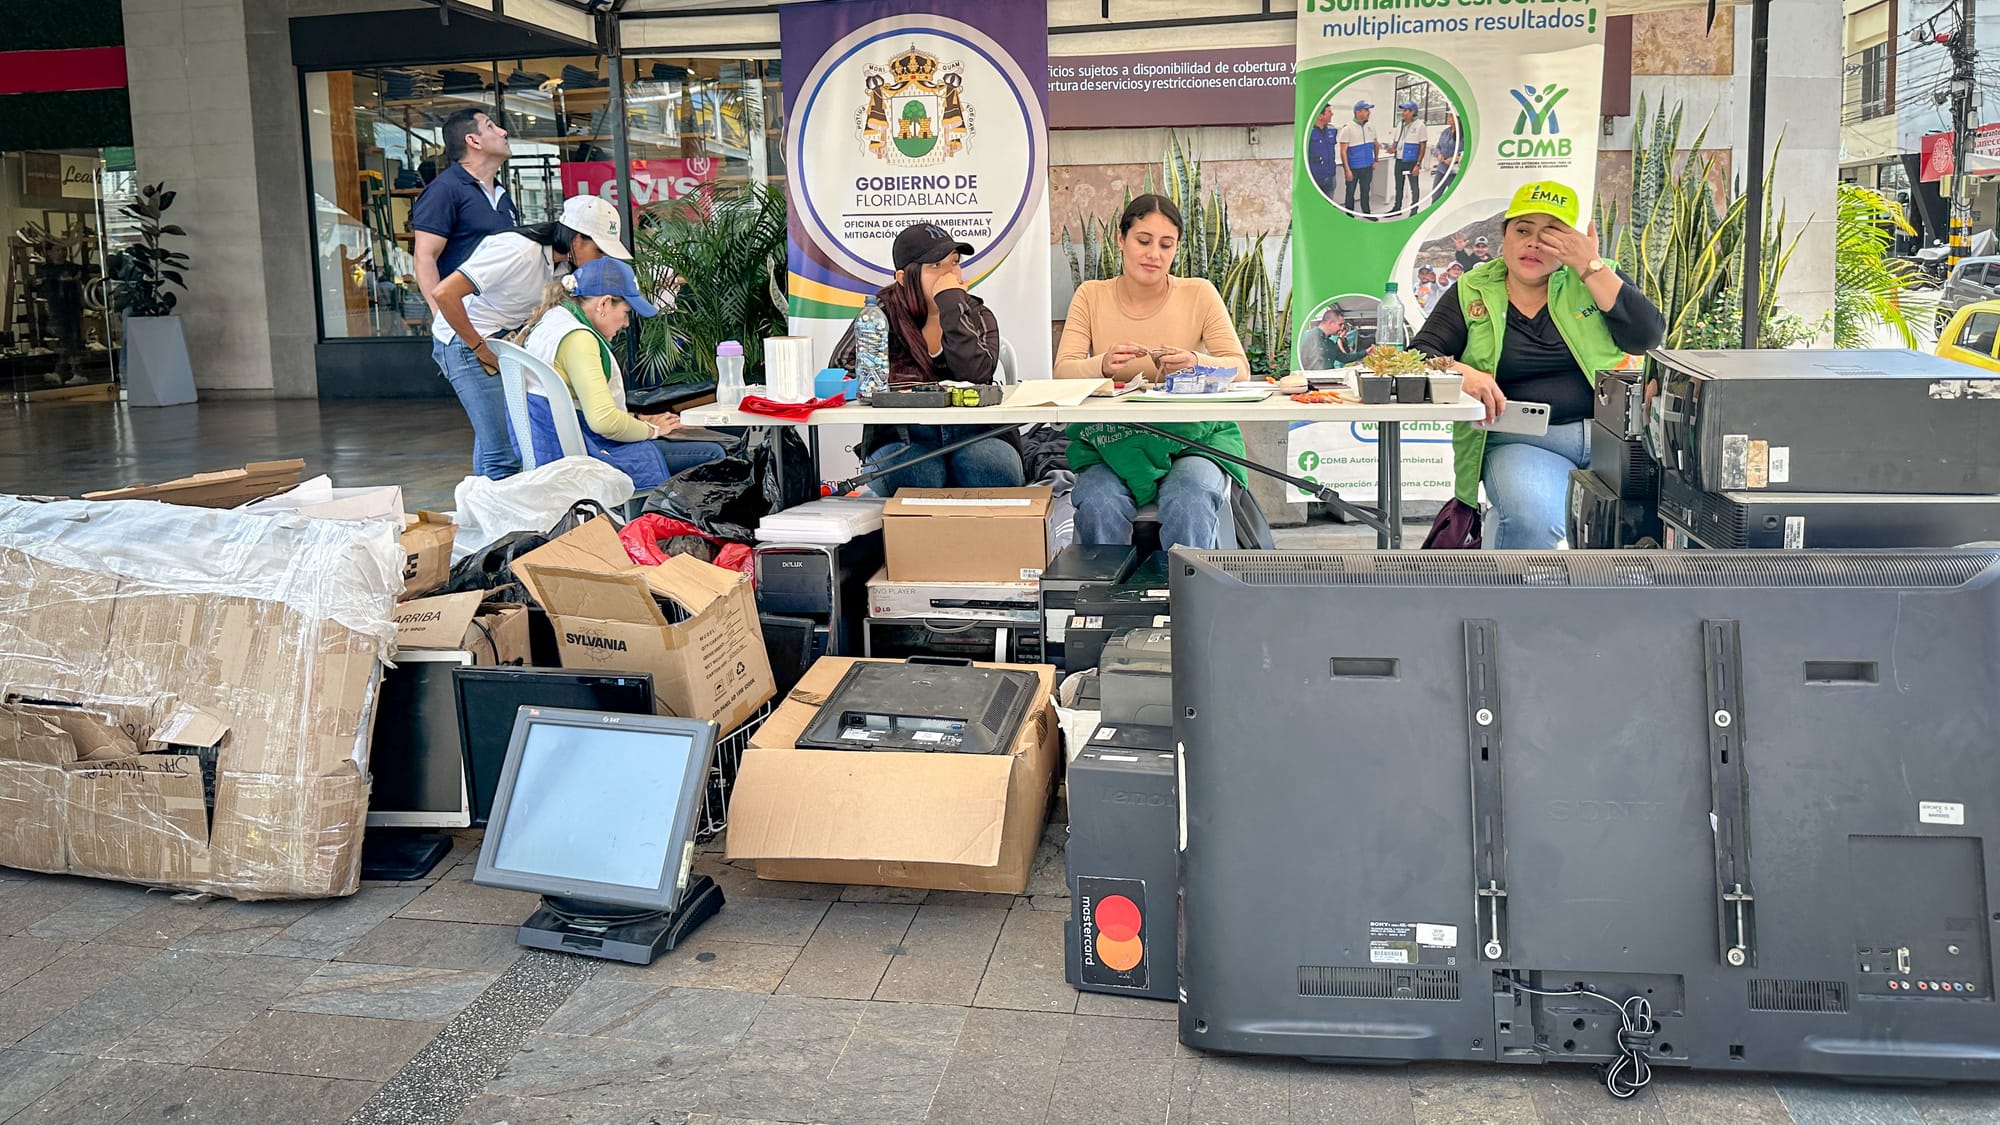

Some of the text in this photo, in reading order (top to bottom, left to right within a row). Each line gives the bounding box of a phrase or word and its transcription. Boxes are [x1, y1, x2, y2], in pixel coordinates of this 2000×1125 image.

[1323, 14, 1468, 40] multiplicamos
[942, 61, 960, 71] QUAM
[1078, 64, 1118, 79] sujetos
[1122, 66, 1129, 75] a
[1133, 61, 1211, 77] disponibilidad
[1215, 61, 1229, 74] de
[1233, 61, 1286, 73] cobertura
[1048, 81, 1078, 92] rtura
[1080, 79, 1094, 91] de
[1095, 78, 1143, 90] servicios
[1144, 81, 1151, 92] y
[1152, 77, 1221, 89] restricciones
[1222, 78, 1236, 87] en
[1497, 138, 1572, 158] CDMB
[856, 175, 977, 191] GOBIERNO DE
[856, 192, 978, 207] FLORIDABLANCA
[1531, 190, 1568, 205] EMAF
[844, 220, 879, 228] OFICINA
[882, 220, 894, 228] DE
[895, 217, 933, 227] GESTIÓN
[934, 218, 984, 227] AMBIENTAL
[844, 227, 992, 239] MITIGACIÓN (OGAMR)
[1320, 456, 1443, 465] CDMB Autori mbiental
[1423, 480, 1451, 488] CDMB
[392, 611, 441, 624] ARRIBA
[566, 633, 628, 652] SYLVANIA
[1082, 896, 1095, 967] mastercard
